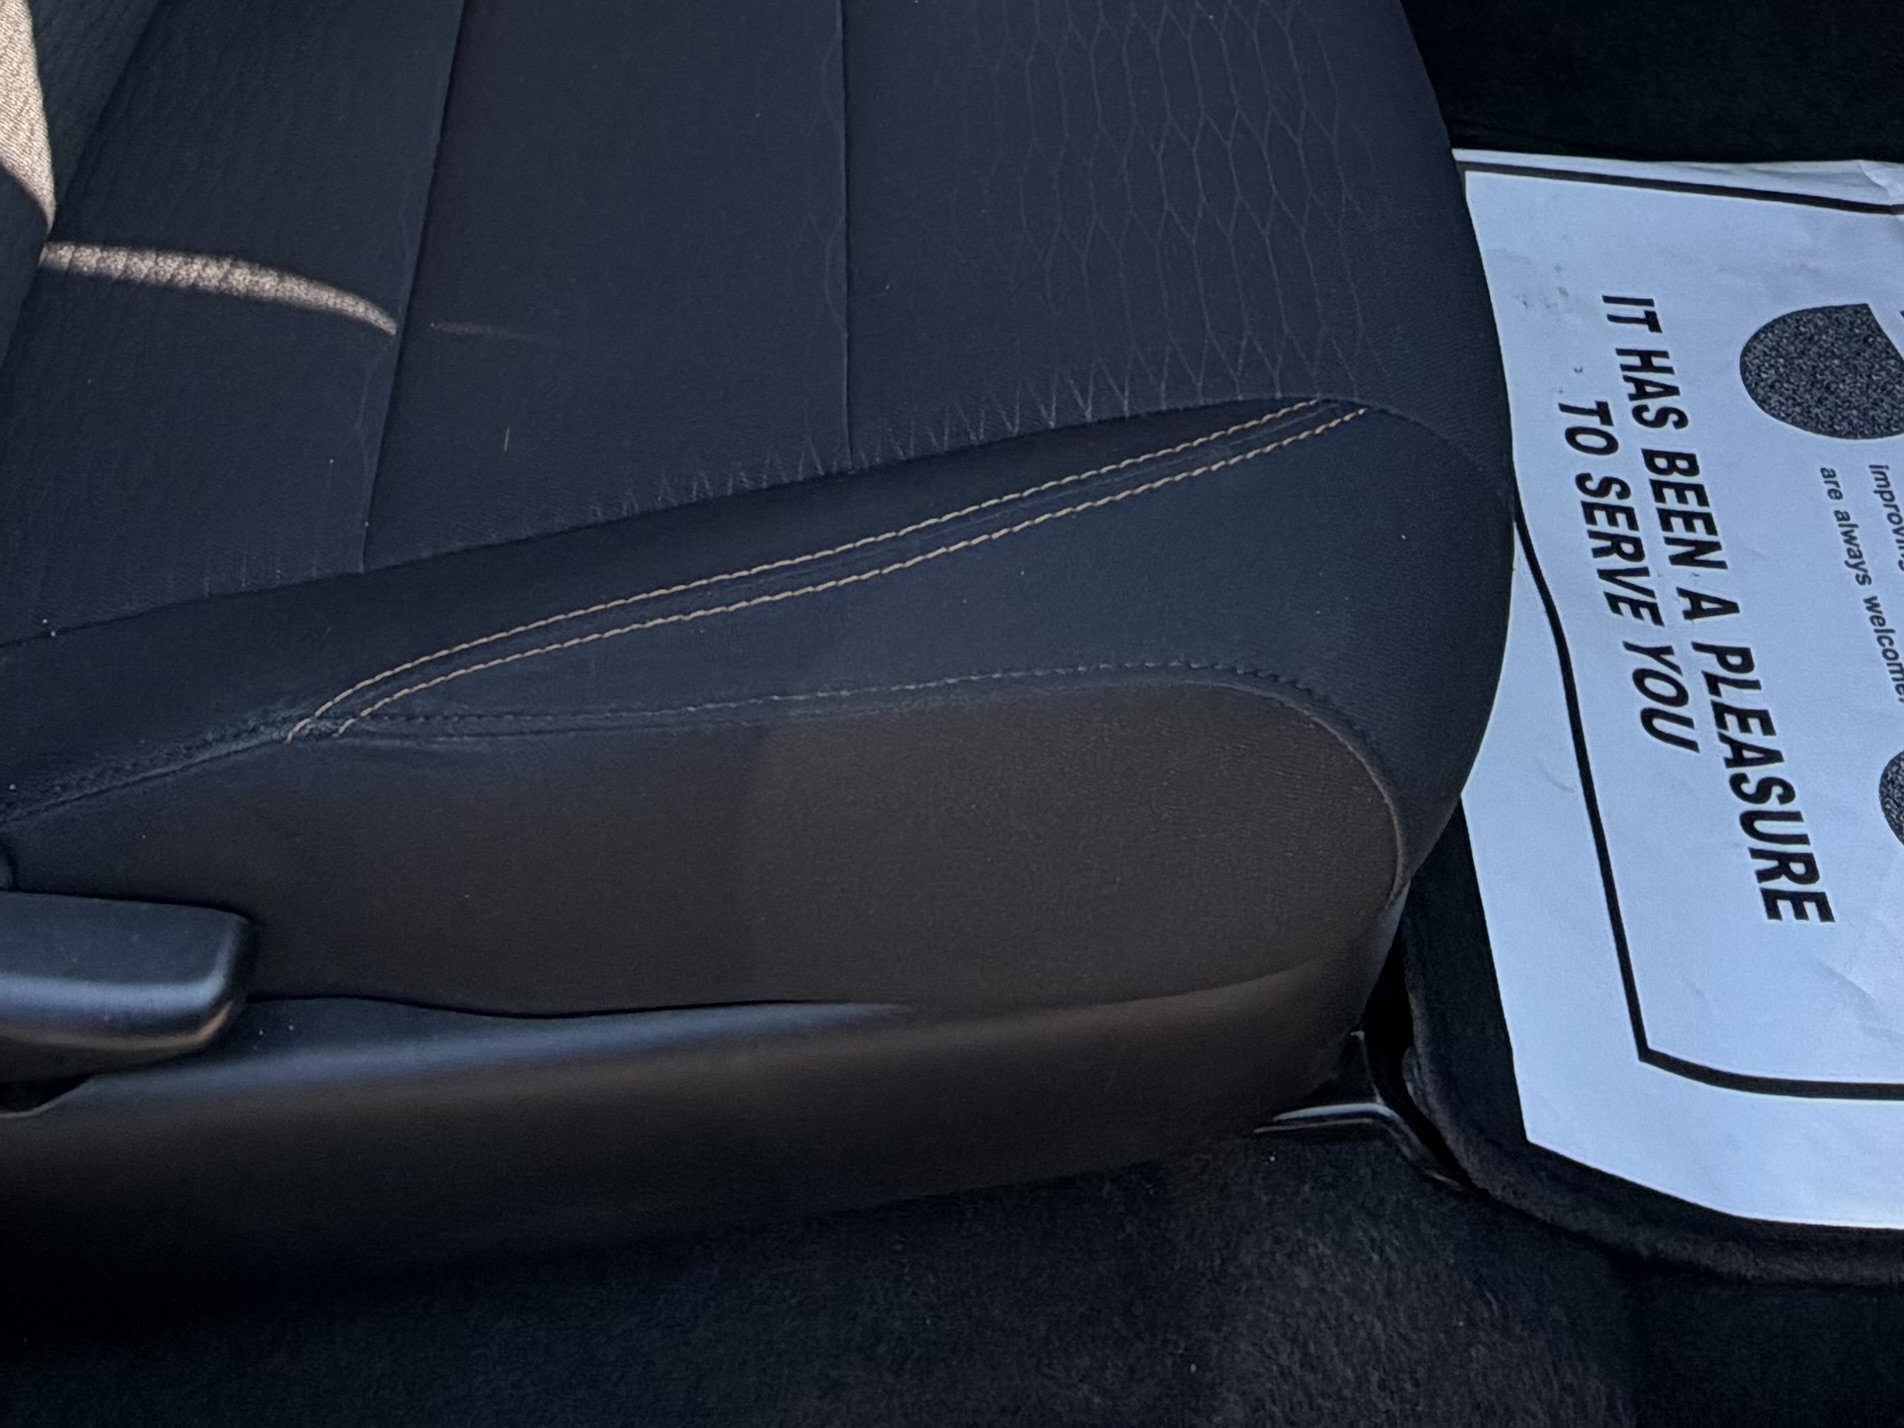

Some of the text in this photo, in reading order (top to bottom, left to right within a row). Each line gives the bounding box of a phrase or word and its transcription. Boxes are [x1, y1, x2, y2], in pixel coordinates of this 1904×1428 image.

[1558, 399, 1701, 754] TO SERVE YOU
[1601, 294, 1836, 924] IT HAS BEEN A PLEASURE
[1820, 466, 1844, 501] are
[1834, 509, 1872, 586] always
